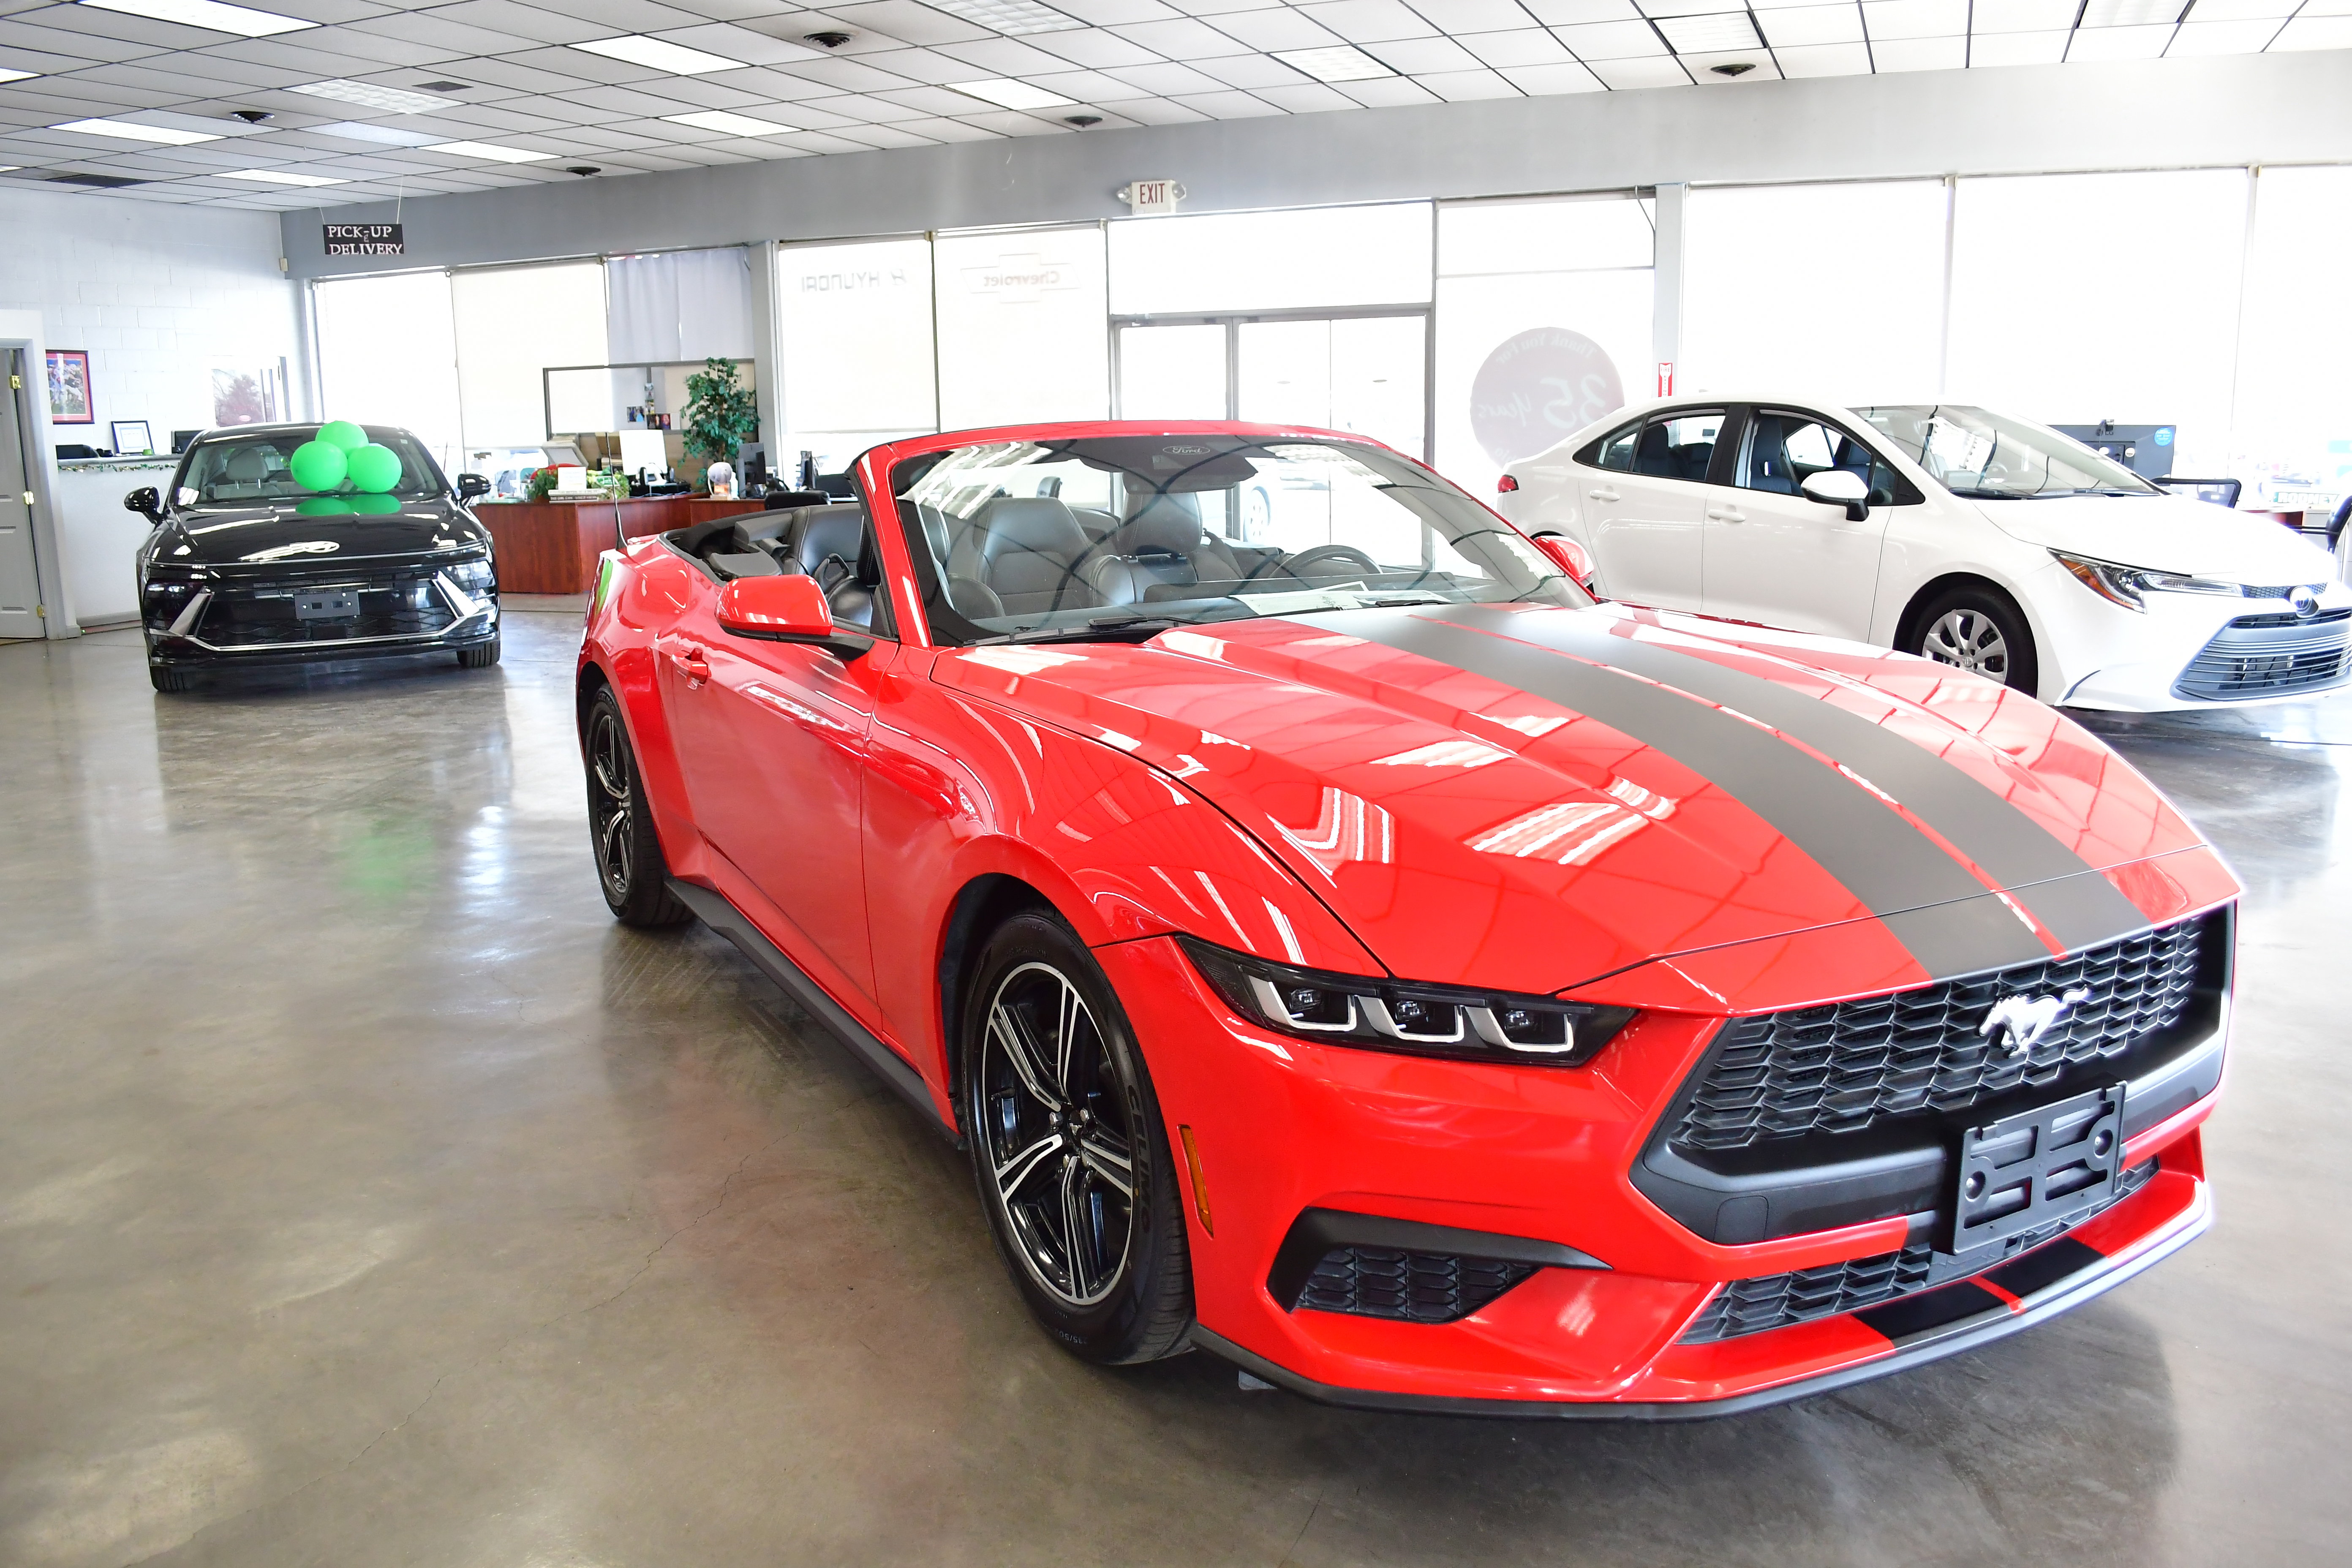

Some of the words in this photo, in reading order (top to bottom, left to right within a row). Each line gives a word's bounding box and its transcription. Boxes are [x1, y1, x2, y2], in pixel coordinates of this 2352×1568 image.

[1140, 183, 1165, 204] EXIT
[328, 226, 392, 238] PICK-UP
[329, 243, 403, 255] DELIVERY
[2277, 492, 2340, 504] RODNEY
